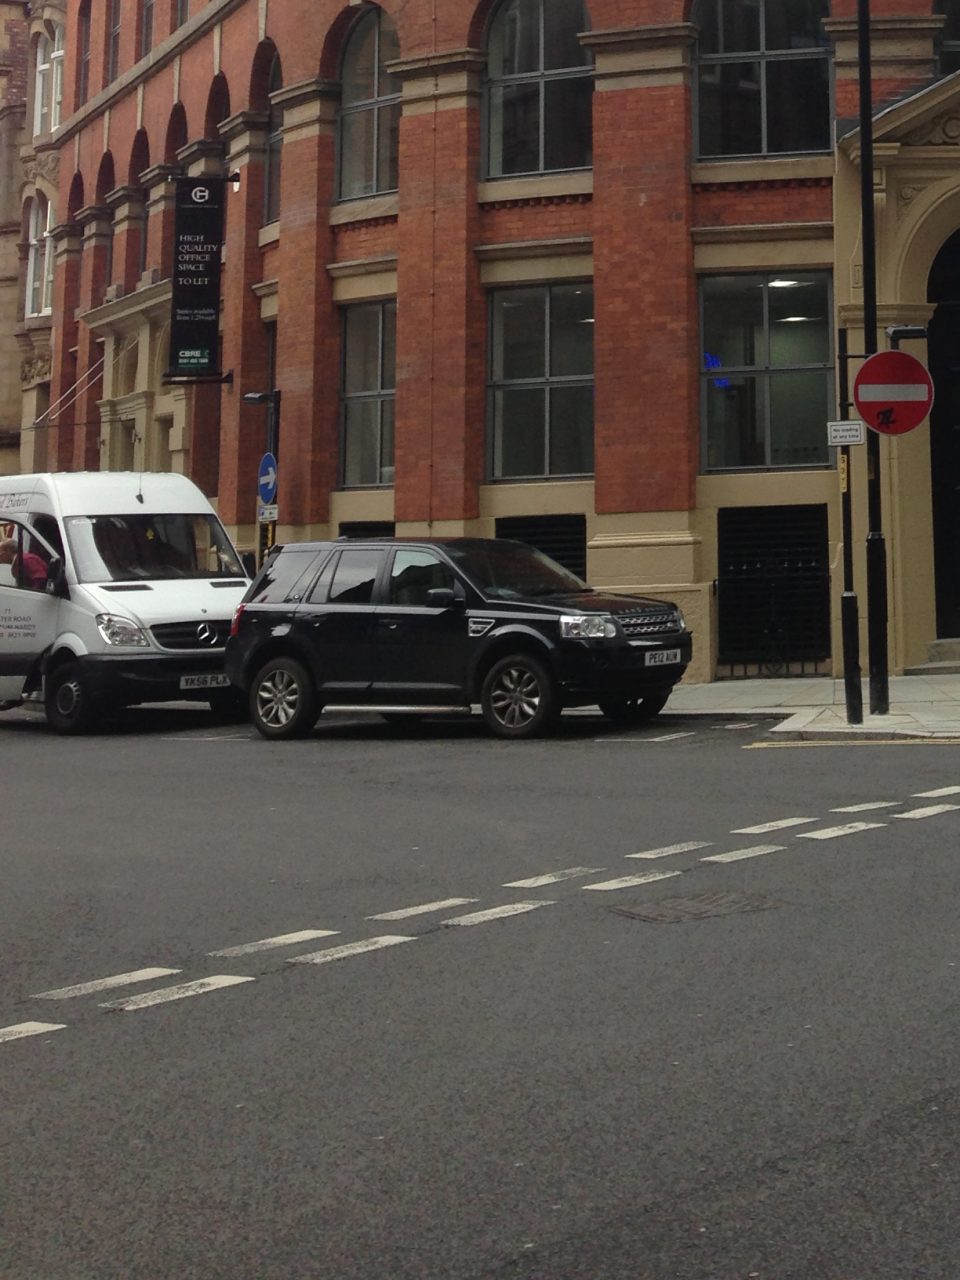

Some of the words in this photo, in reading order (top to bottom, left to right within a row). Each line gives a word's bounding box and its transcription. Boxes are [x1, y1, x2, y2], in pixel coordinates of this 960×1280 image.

[179, 234, 205, 242] HIGH
[178, 244, 218, 254] QUALITY
[178, 263, 205, 271] SPACE
[178, 277, 192, 285] TO
[193, 277, 208, 285] LET
